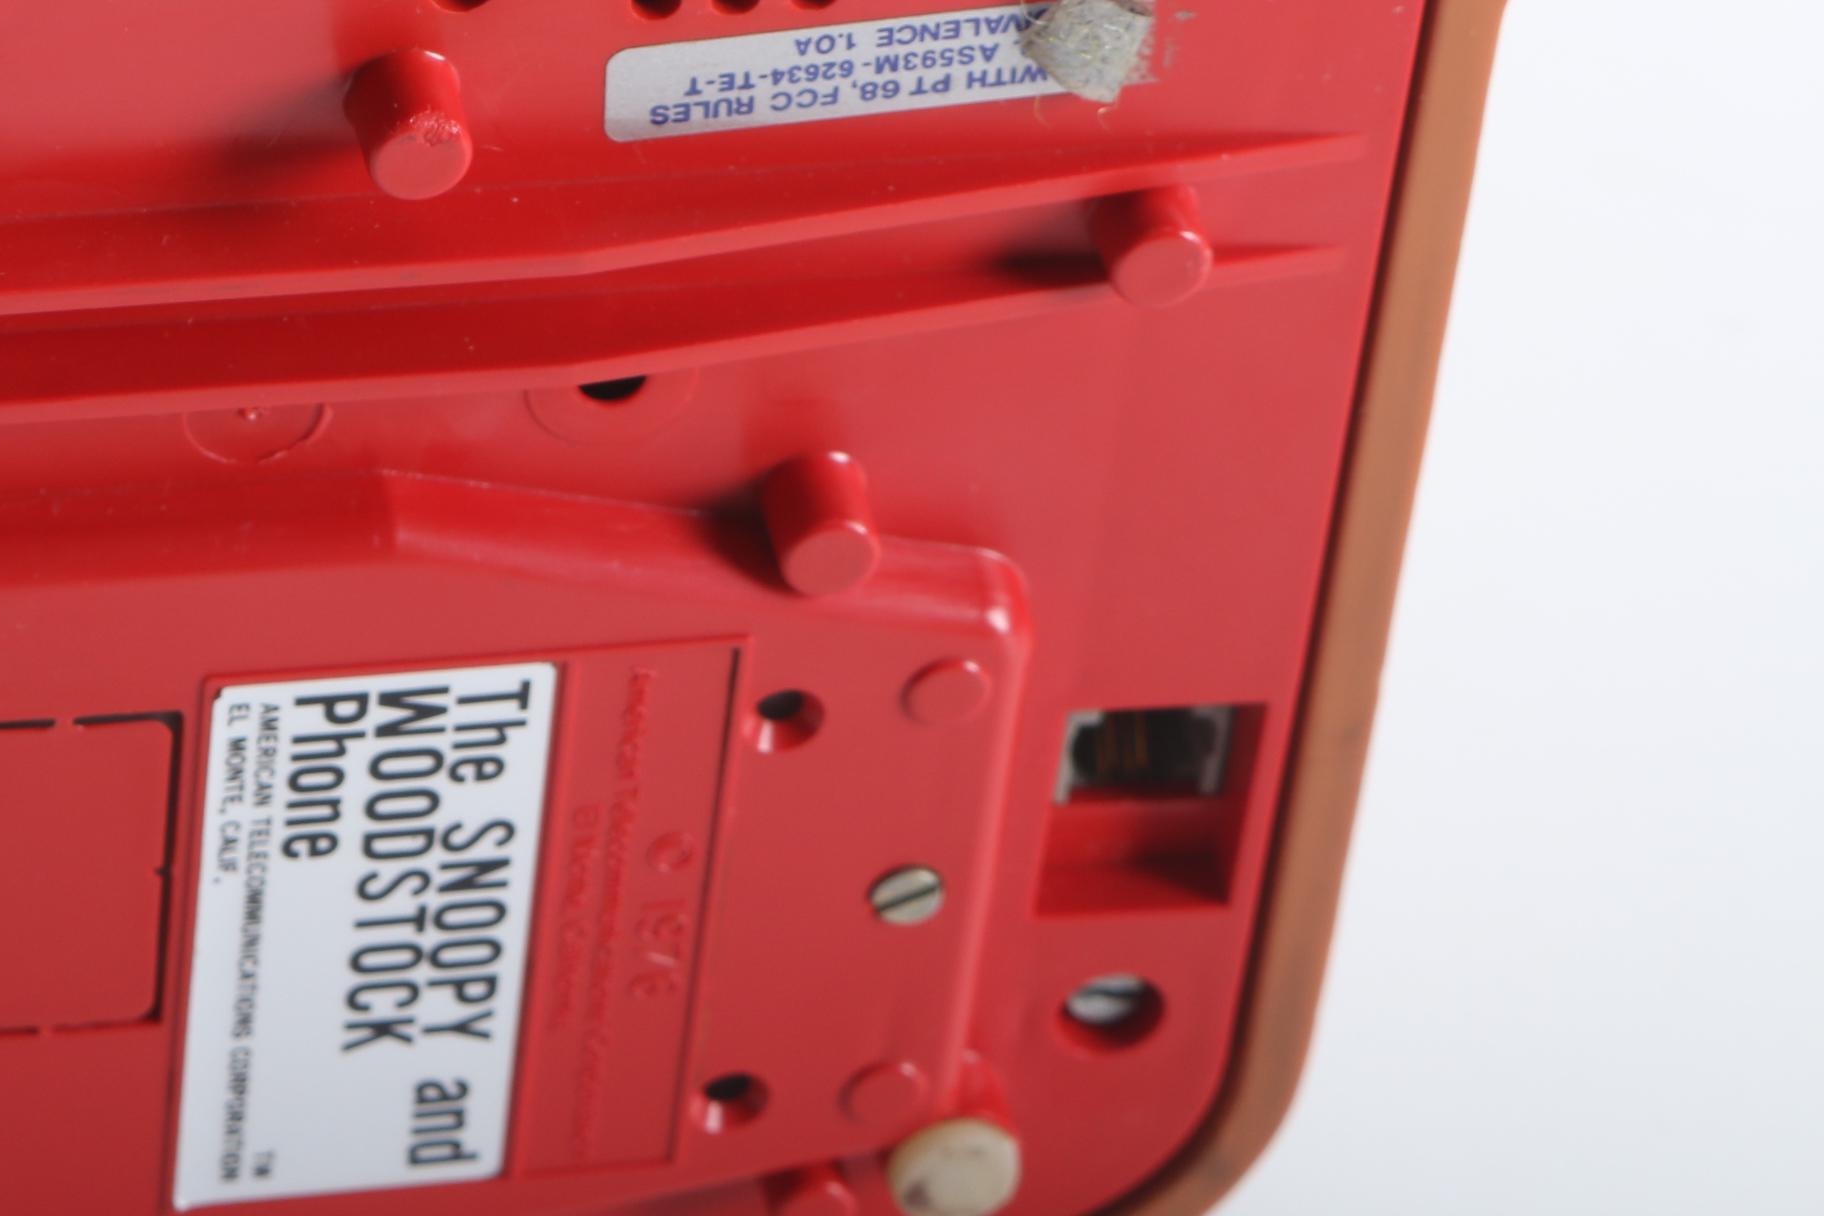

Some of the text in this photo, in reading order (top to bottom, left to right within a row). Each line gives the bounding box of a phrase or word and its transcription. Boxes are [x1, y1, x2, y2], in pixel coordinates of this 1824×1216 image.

[648, 64, 1048, 126] WITH PT 68, FCC RULES
[212, 703, 251, 885] EL MONTE, CALIF.
[282, 691, 370, 861] Phone
[341, 686, 450, 1054] WOODSTOCK
[219, 703, 281, 1182] AMERICAN TELECOMMUNICATIONS CORPORATION
[407, 680, 531, 1168] The SNOOPY and
